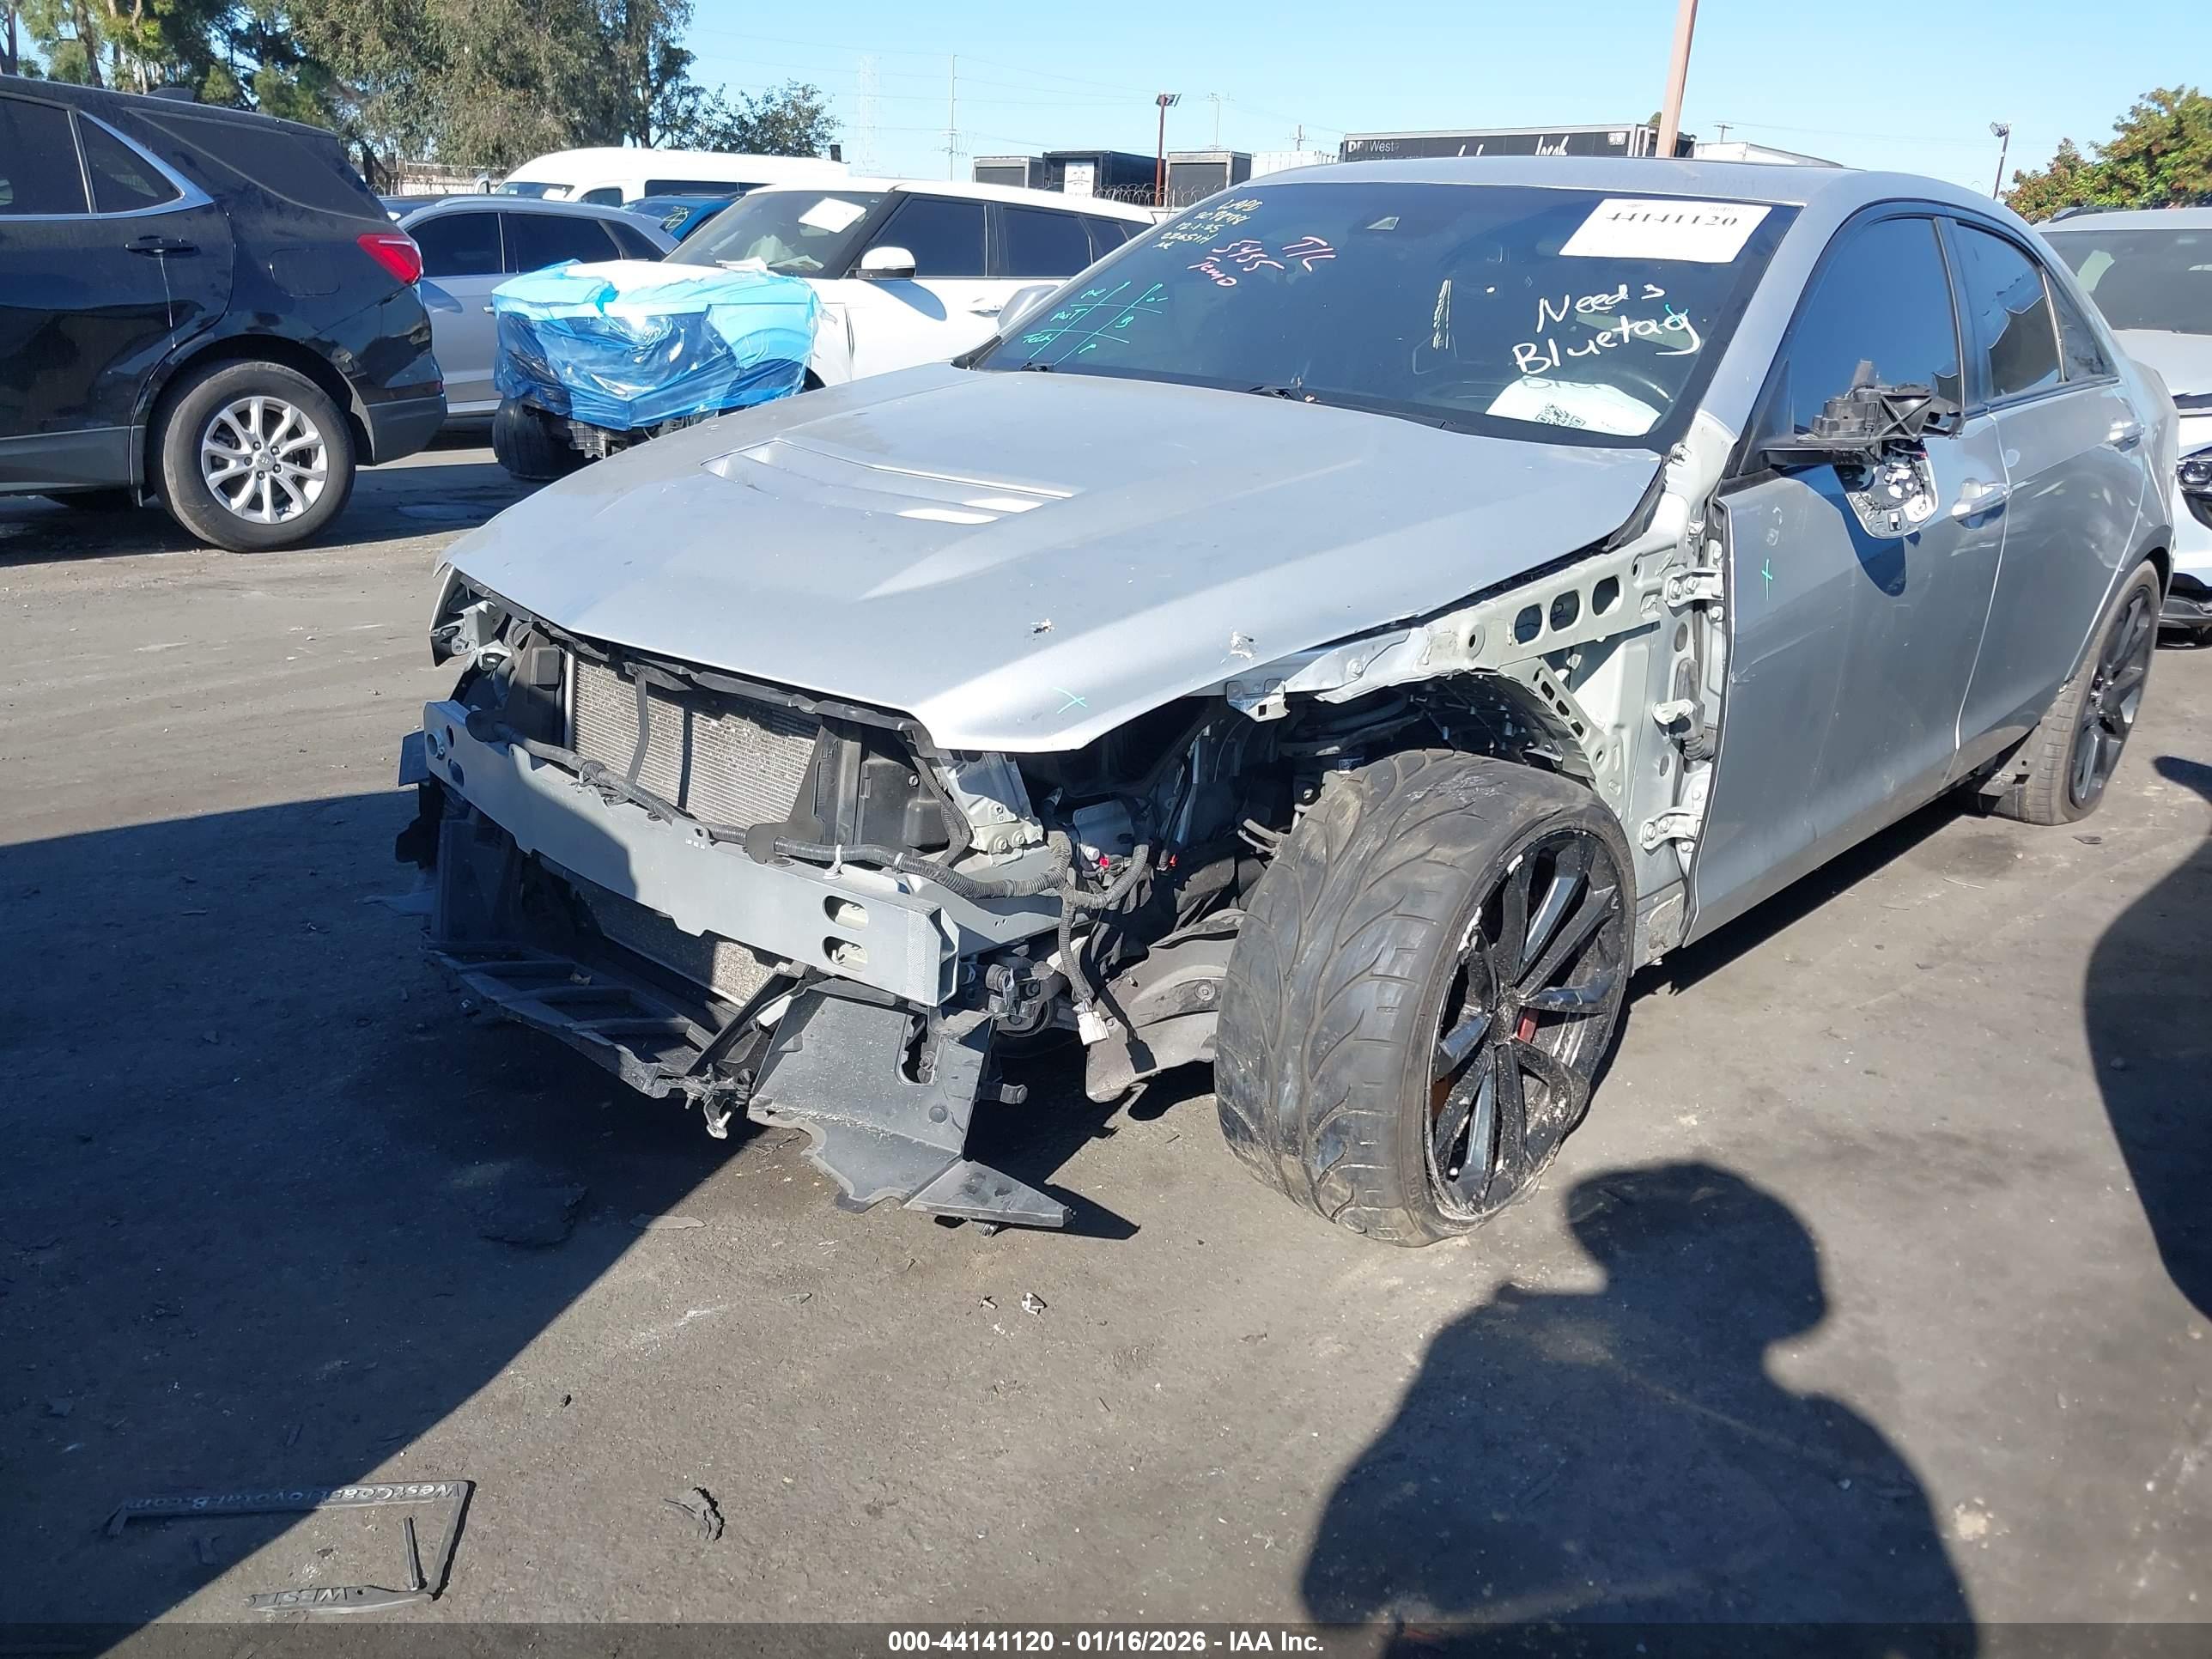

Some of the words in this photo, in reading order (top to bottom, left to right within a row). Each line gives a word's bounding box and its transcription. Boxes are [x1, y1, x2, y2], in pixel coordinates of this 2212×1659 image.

[1370, 140, 1395, 152] West
[1606, 212, 1738, 226] 44141120
[1536, 283, 1666, 334] Needs
[1511, 314, 1702, 374] Bluetag
